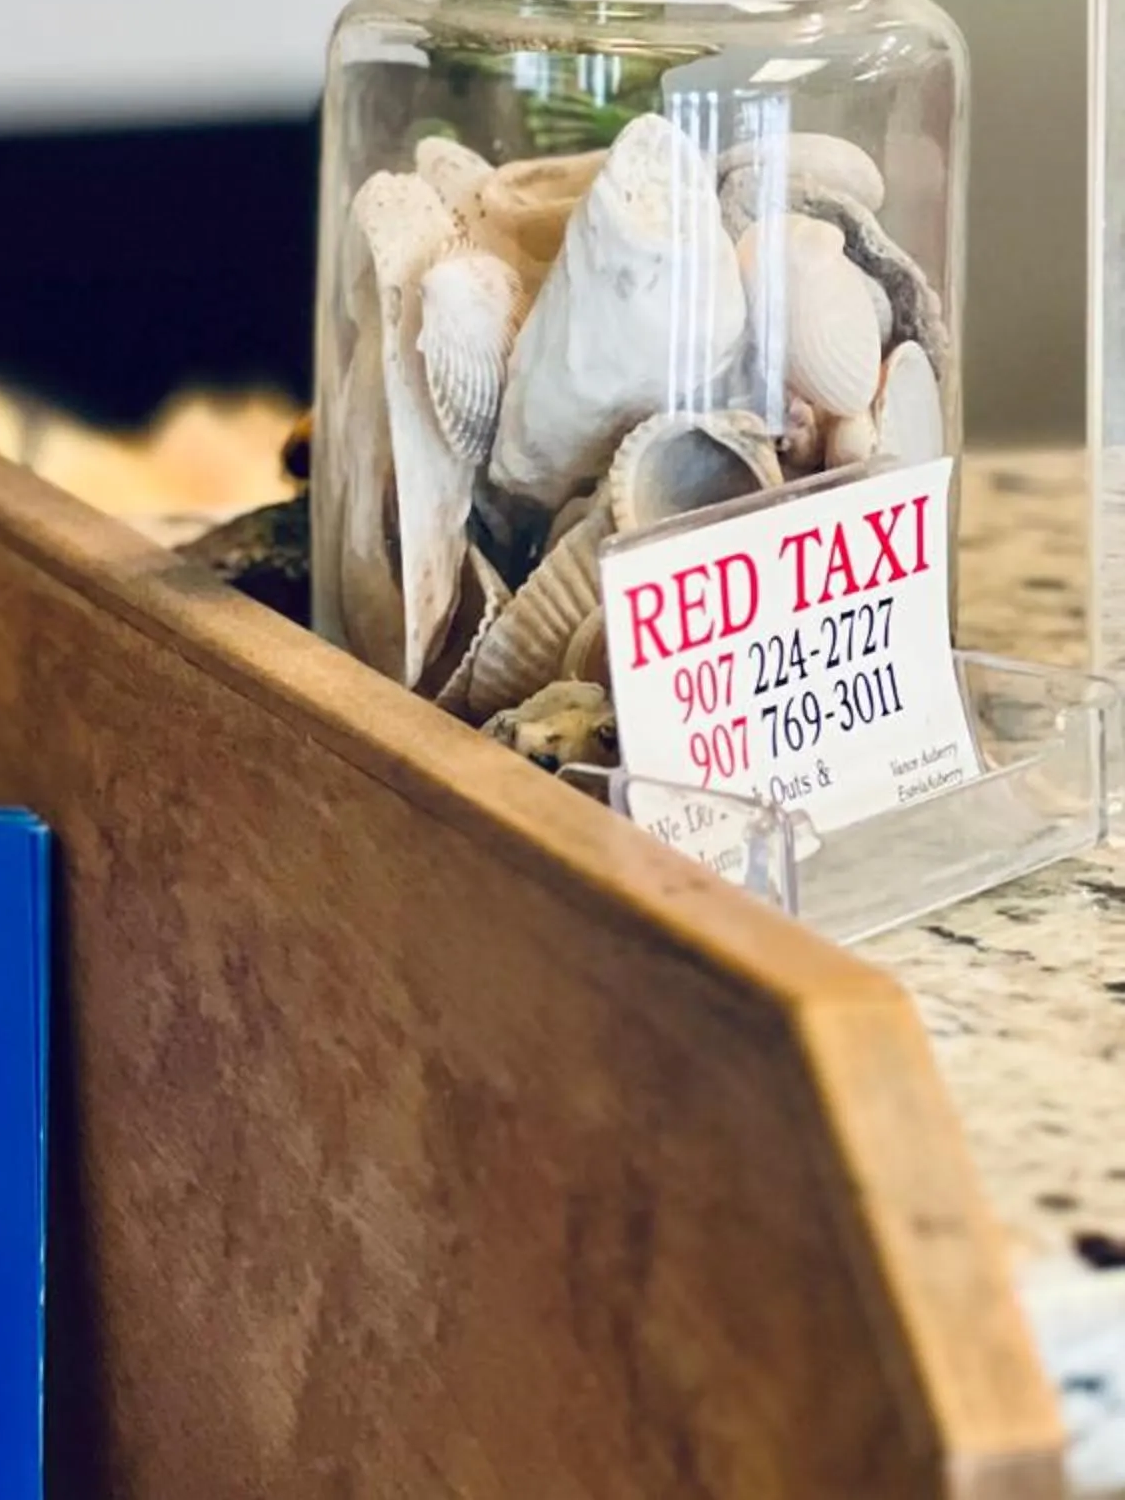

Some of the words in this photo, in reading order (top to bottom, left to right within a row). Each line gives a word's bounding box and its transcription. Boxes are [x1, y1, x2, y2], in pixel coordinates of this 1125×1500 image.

[623, 550, 760, 671] RED
[778, 494, 931, 613] TAXI
[674, 653, 735, 724] 907
[748, 597, 895, 696] 224-2727
[690, 716, 752, 790] 907
[761, 662, 905, 760] 769-3011
[770, 774, 813, 806] Outs
[816, 758, 835, 788] &
